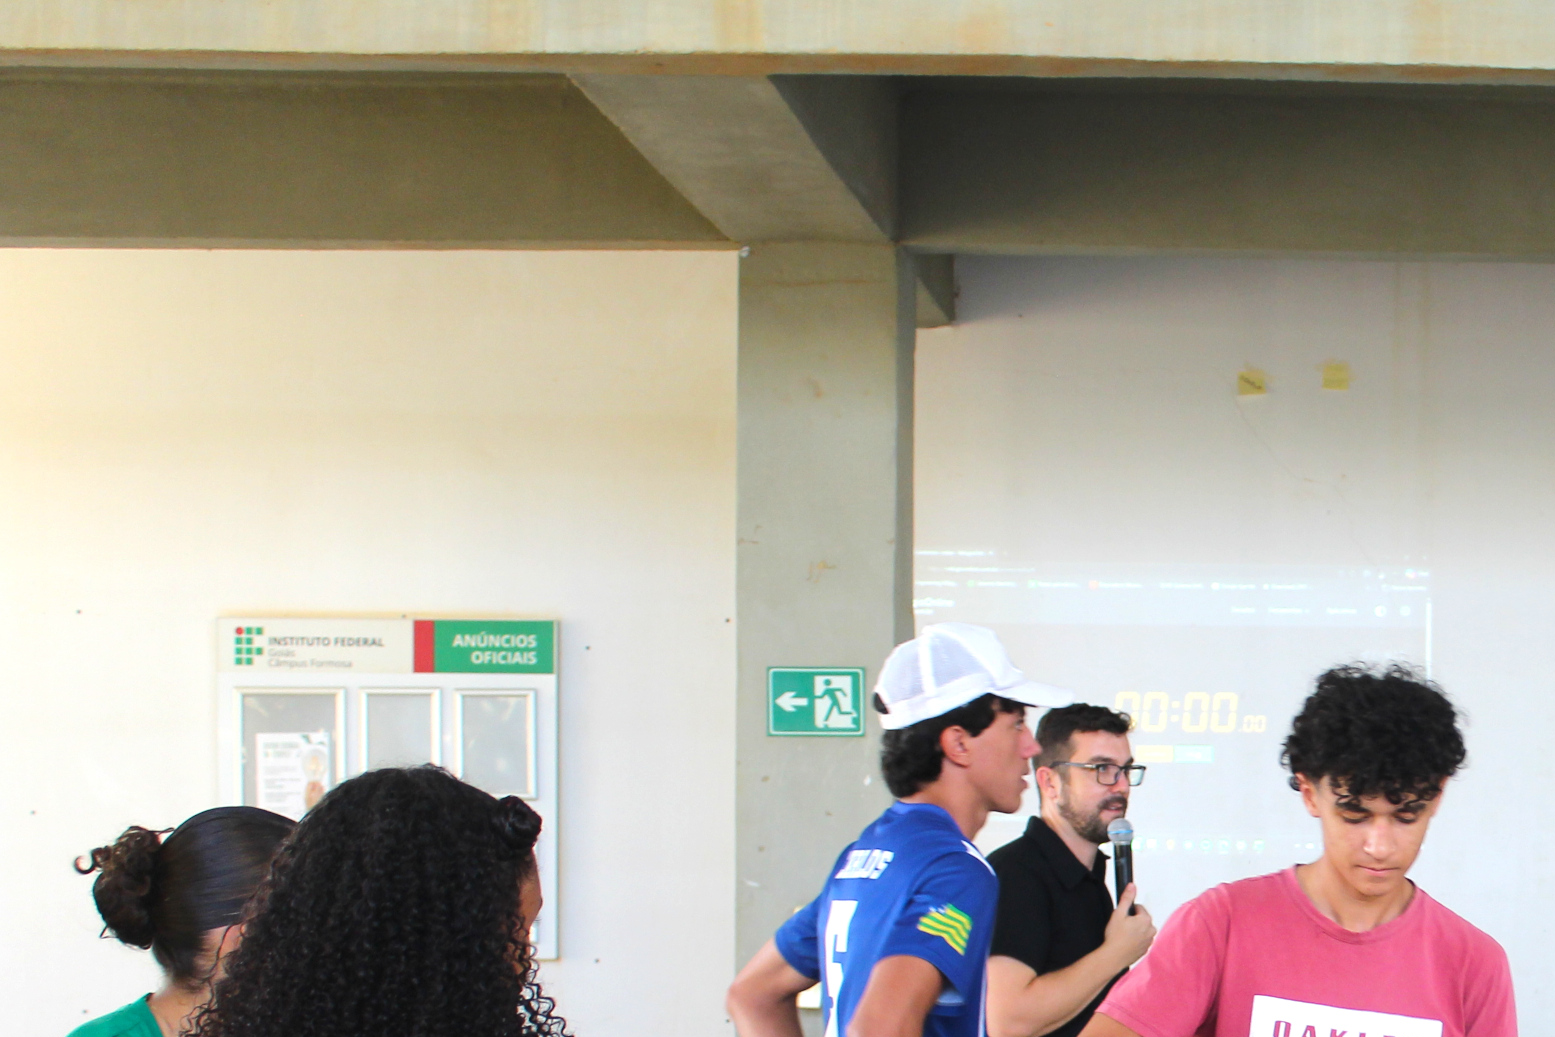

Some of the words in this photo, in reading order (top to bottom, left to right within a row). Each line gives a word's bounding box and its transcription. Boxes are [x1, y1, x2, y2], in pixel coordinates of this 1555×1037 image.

[267, 636, 331, 647] INSTITUTO
[333, 636, 386, 648] FEDERAL
[451, 631, 538, 648] ANÚNCIOS
[309, 657, 354, 668] Formosa
[470, 650, 538, 666] OFICIAIS
